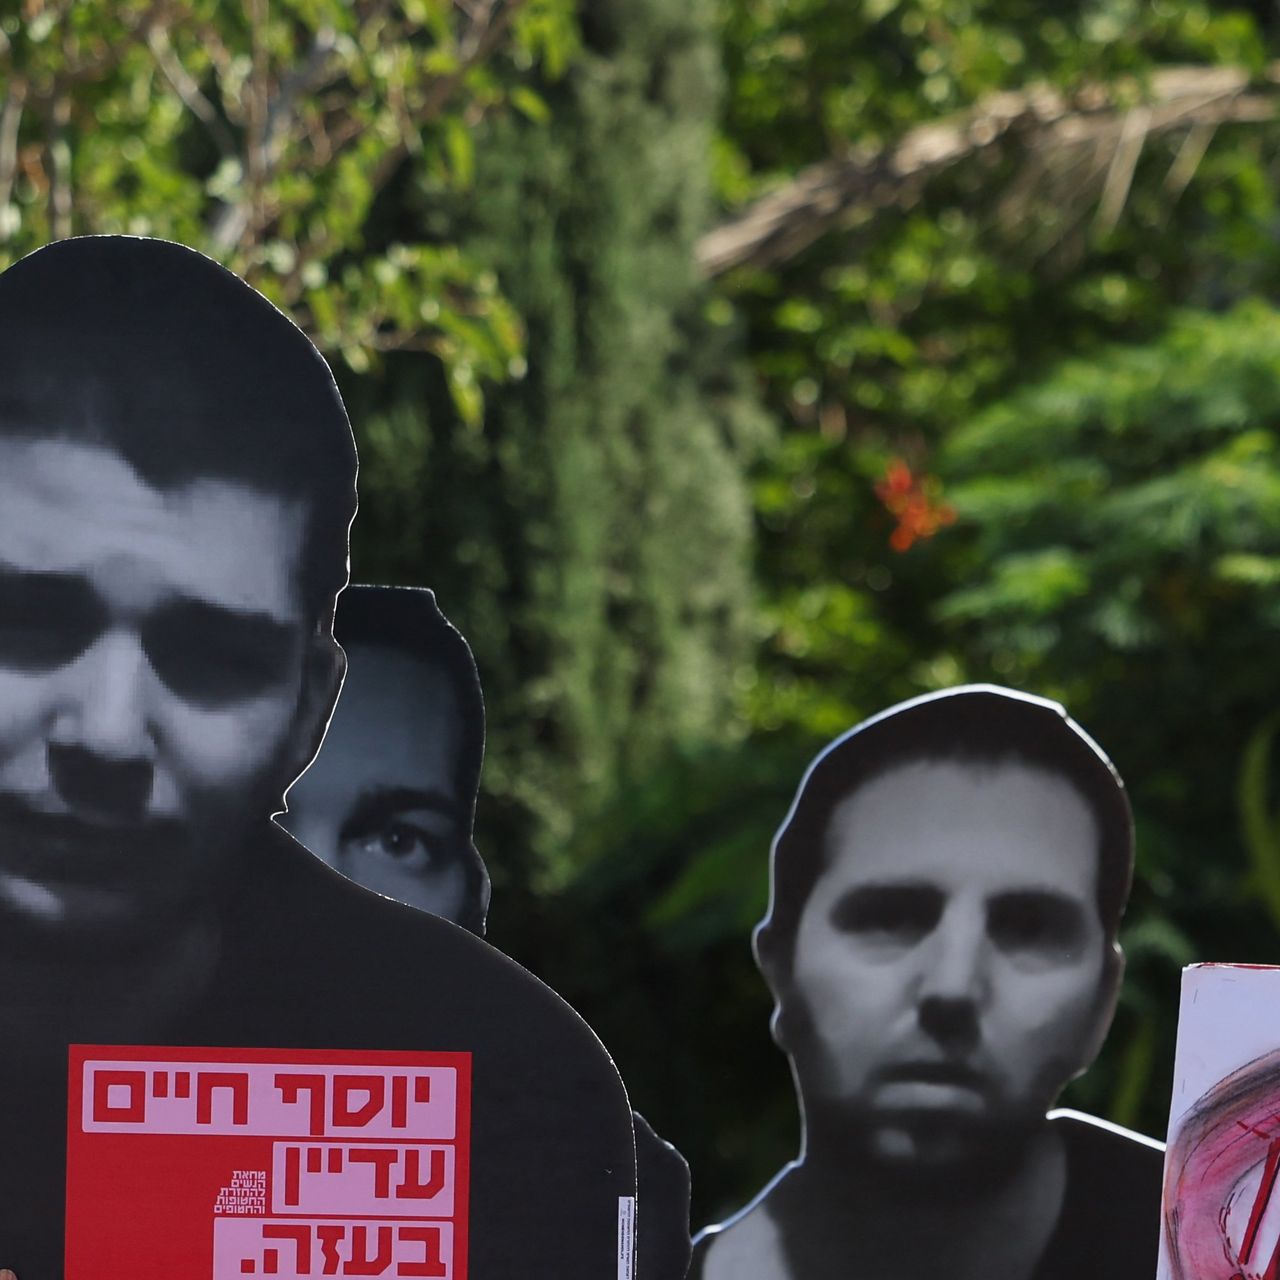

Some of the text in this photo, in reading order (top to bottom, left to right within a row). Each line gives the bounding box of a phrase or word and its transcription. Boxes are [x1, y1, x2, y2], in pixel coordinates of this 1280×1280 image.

[93, 1070, 431, 1137] יוסף חיים
[232, 1170, 266, 1180] מחאת
[284, 1146, 446, 1206] עדיין
[231, 1179, 266, 1189] הנשים
[220, 1186, 266, 1197] להחזרת
[216, 1195, 266, 1206] החטופות
[213, 1204, 266, 1214] והחטופים
[240, 1223, 447, 1278] בעזה.
